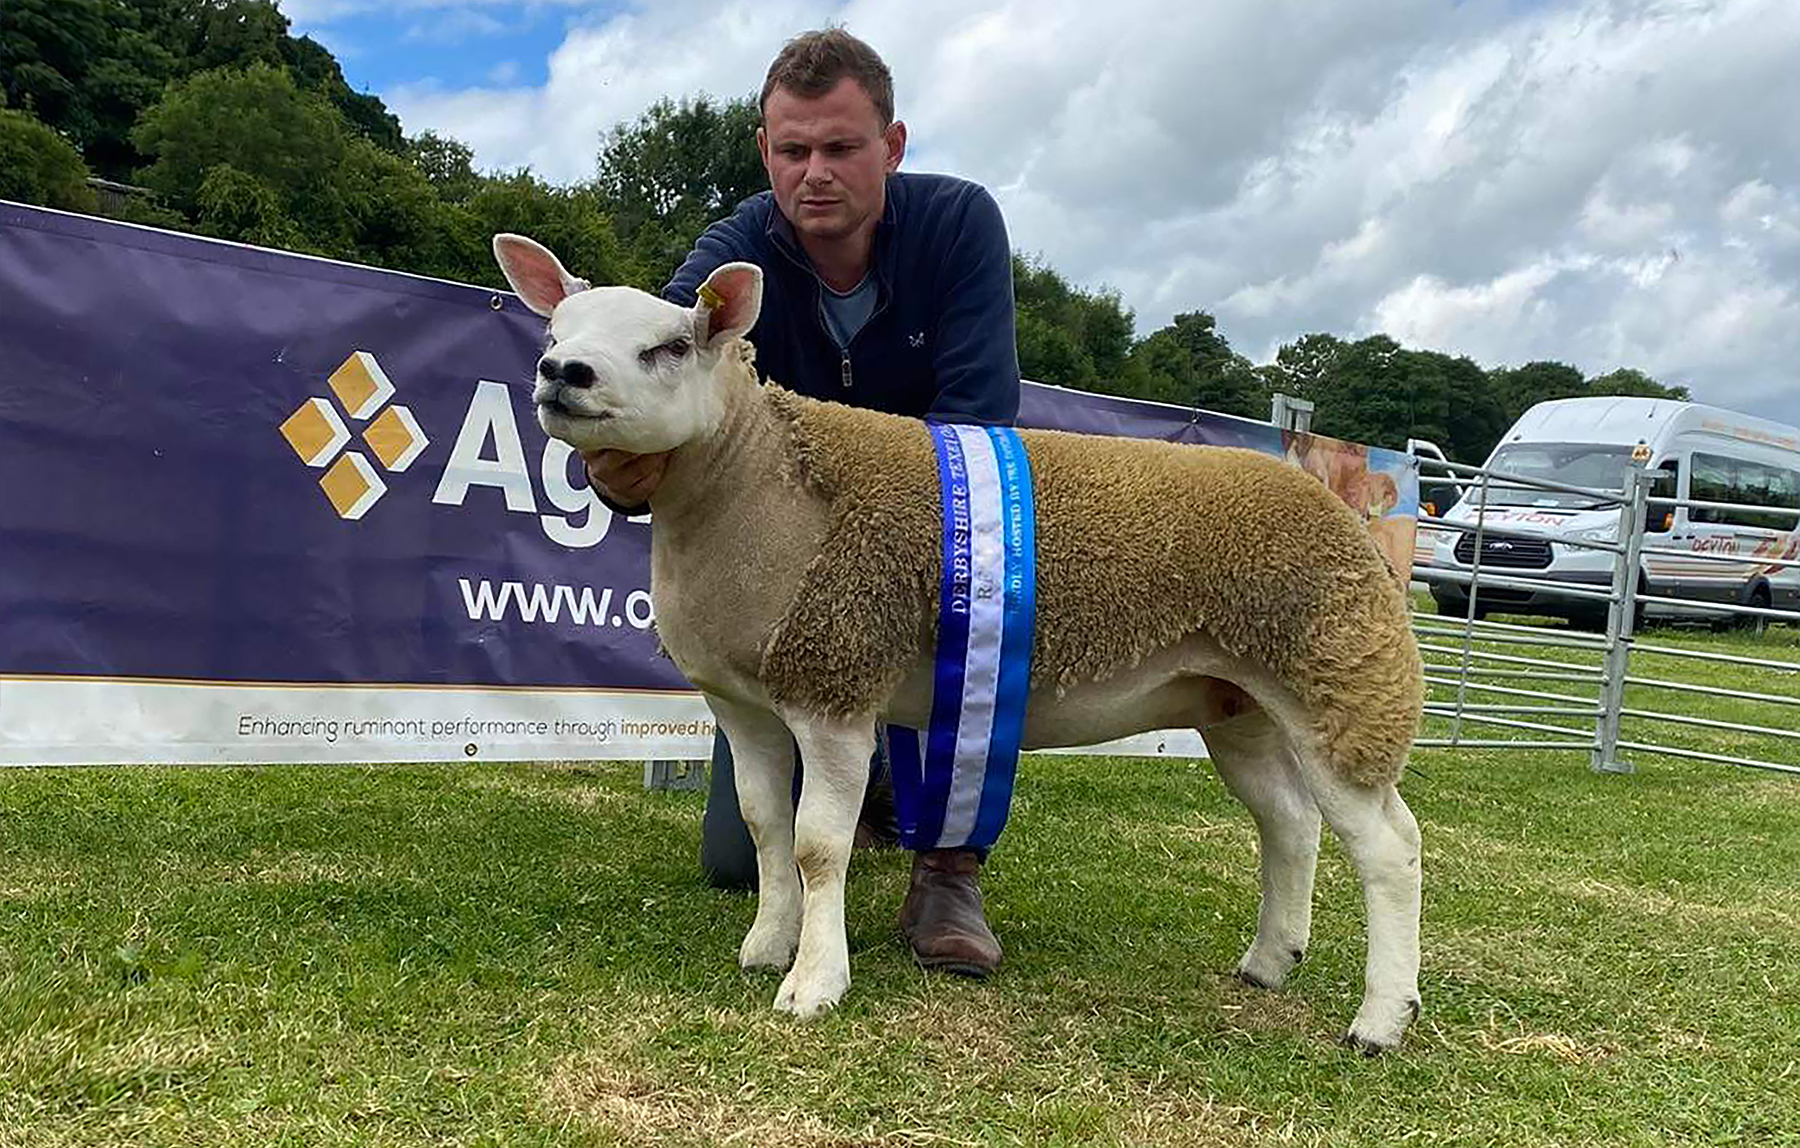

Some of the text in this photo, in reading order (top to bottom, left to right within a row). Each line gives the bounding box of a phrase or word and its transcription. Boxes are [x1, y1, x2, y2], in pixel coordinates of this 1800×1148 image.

[951, 483, 970, 615] DERBYSHIRE
[238, 716, 339, 742] Enhancing
[344, 717, 426, 736] ruminant
[432, 717, 548, 738] performance
[554, 719, 617, 742] through
[621, 718, 699, 738] improved
